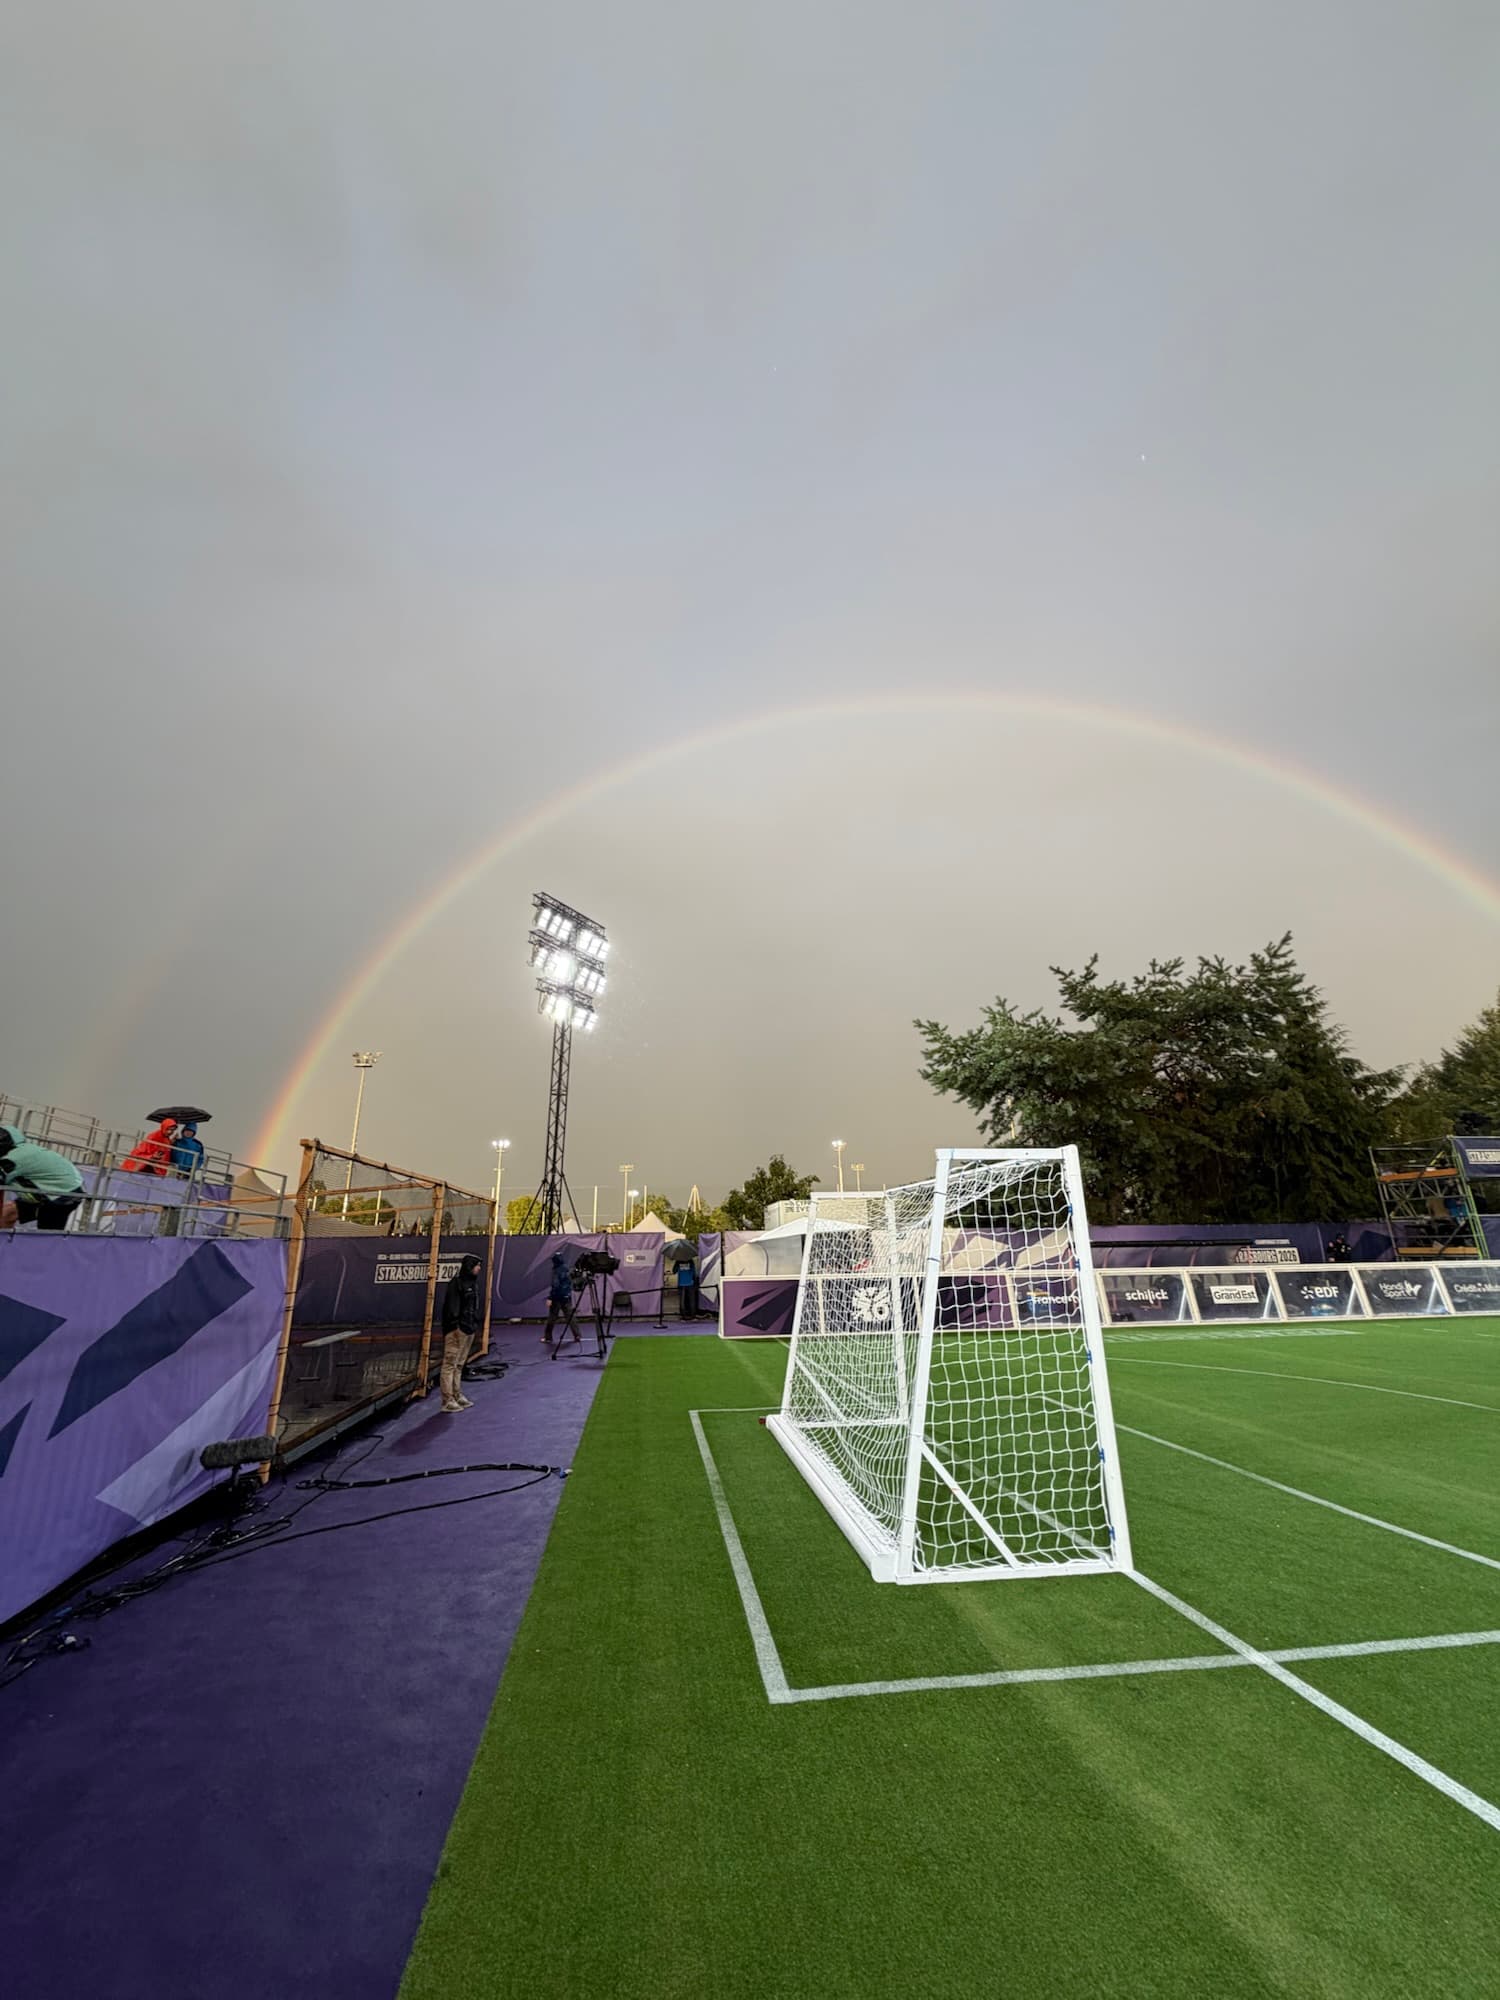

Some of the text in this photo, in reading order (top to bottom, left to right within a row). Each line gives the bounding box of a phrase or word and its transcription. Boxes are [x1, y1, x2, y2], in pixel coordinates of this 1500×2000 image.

[1236, 1250, 1298, 1263] RASBOURG 2026
[378, 1264, 438, 1281] STRASBOU
